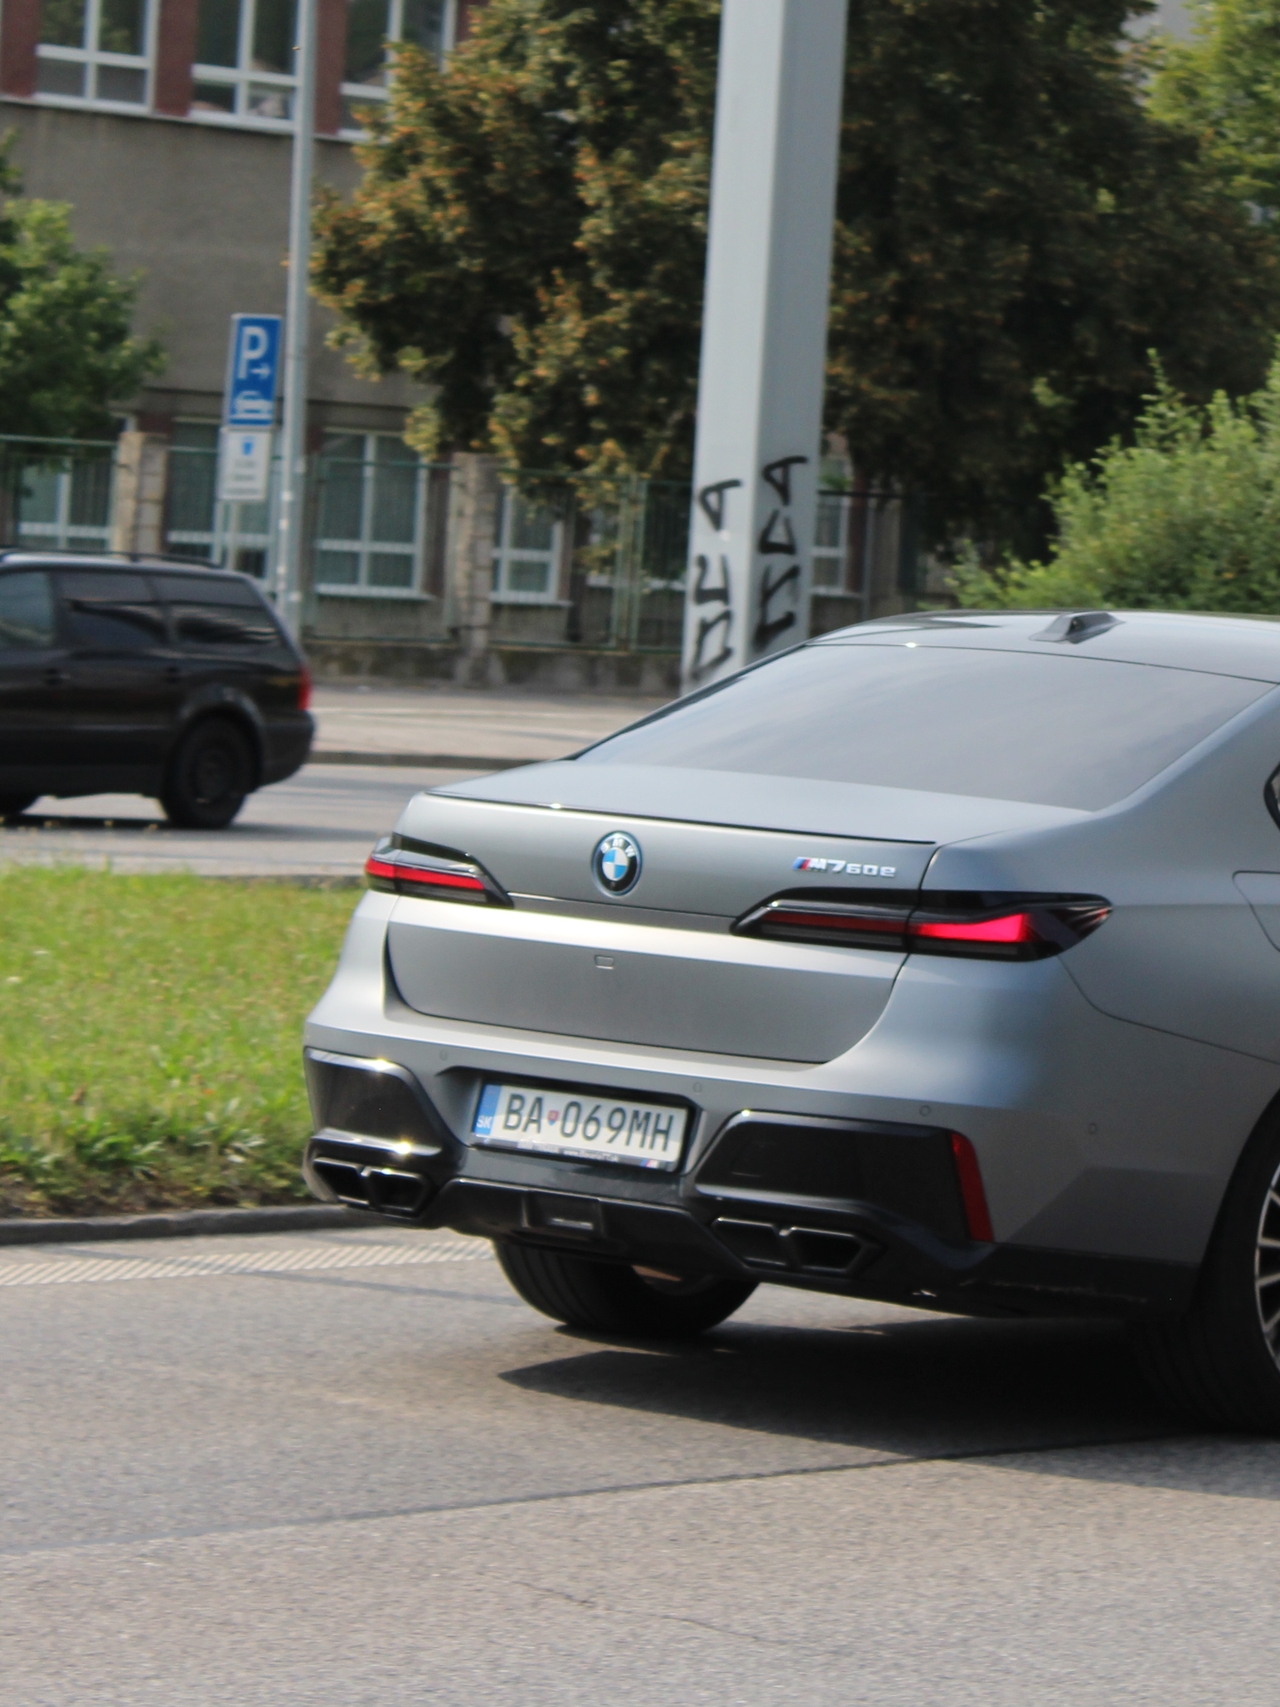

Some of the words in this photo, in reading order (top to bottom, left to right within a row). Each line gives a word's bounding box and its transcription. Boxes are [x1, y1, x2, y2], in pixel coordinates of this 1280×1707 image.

[237, 326, 269, 380] P
[476, 1114, 494, 1129] SK
[503, 1093, 544, 1134] BA
[559, 1101, 675, 1152] 069MH
